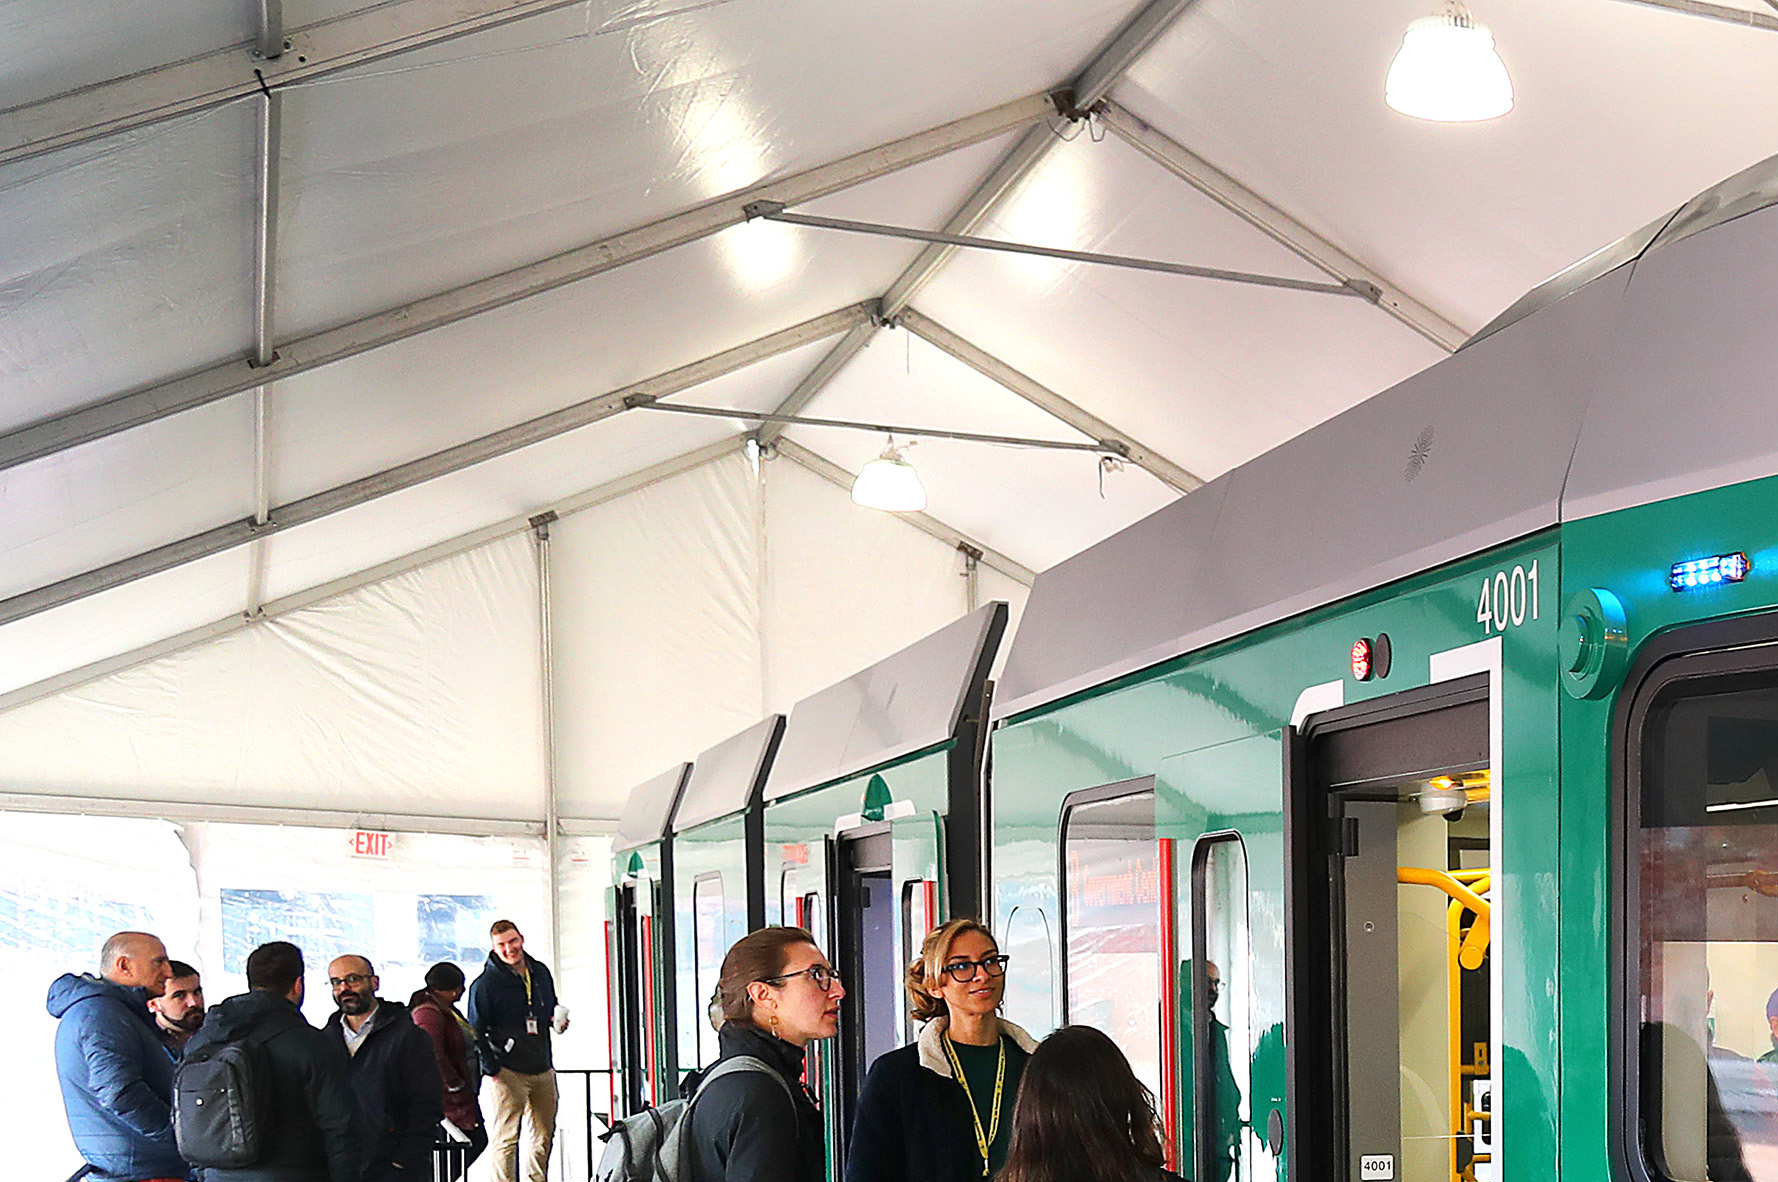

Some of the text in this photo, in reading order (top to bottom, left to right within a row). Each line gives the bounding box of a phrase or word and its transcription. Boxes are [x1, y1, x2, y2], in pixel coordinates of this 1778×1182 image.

[1476, 559, 1540, 635] 4001
[355, 832, 389, 856] EXIT
[1363, 1161, 1392, 1172] 4001
